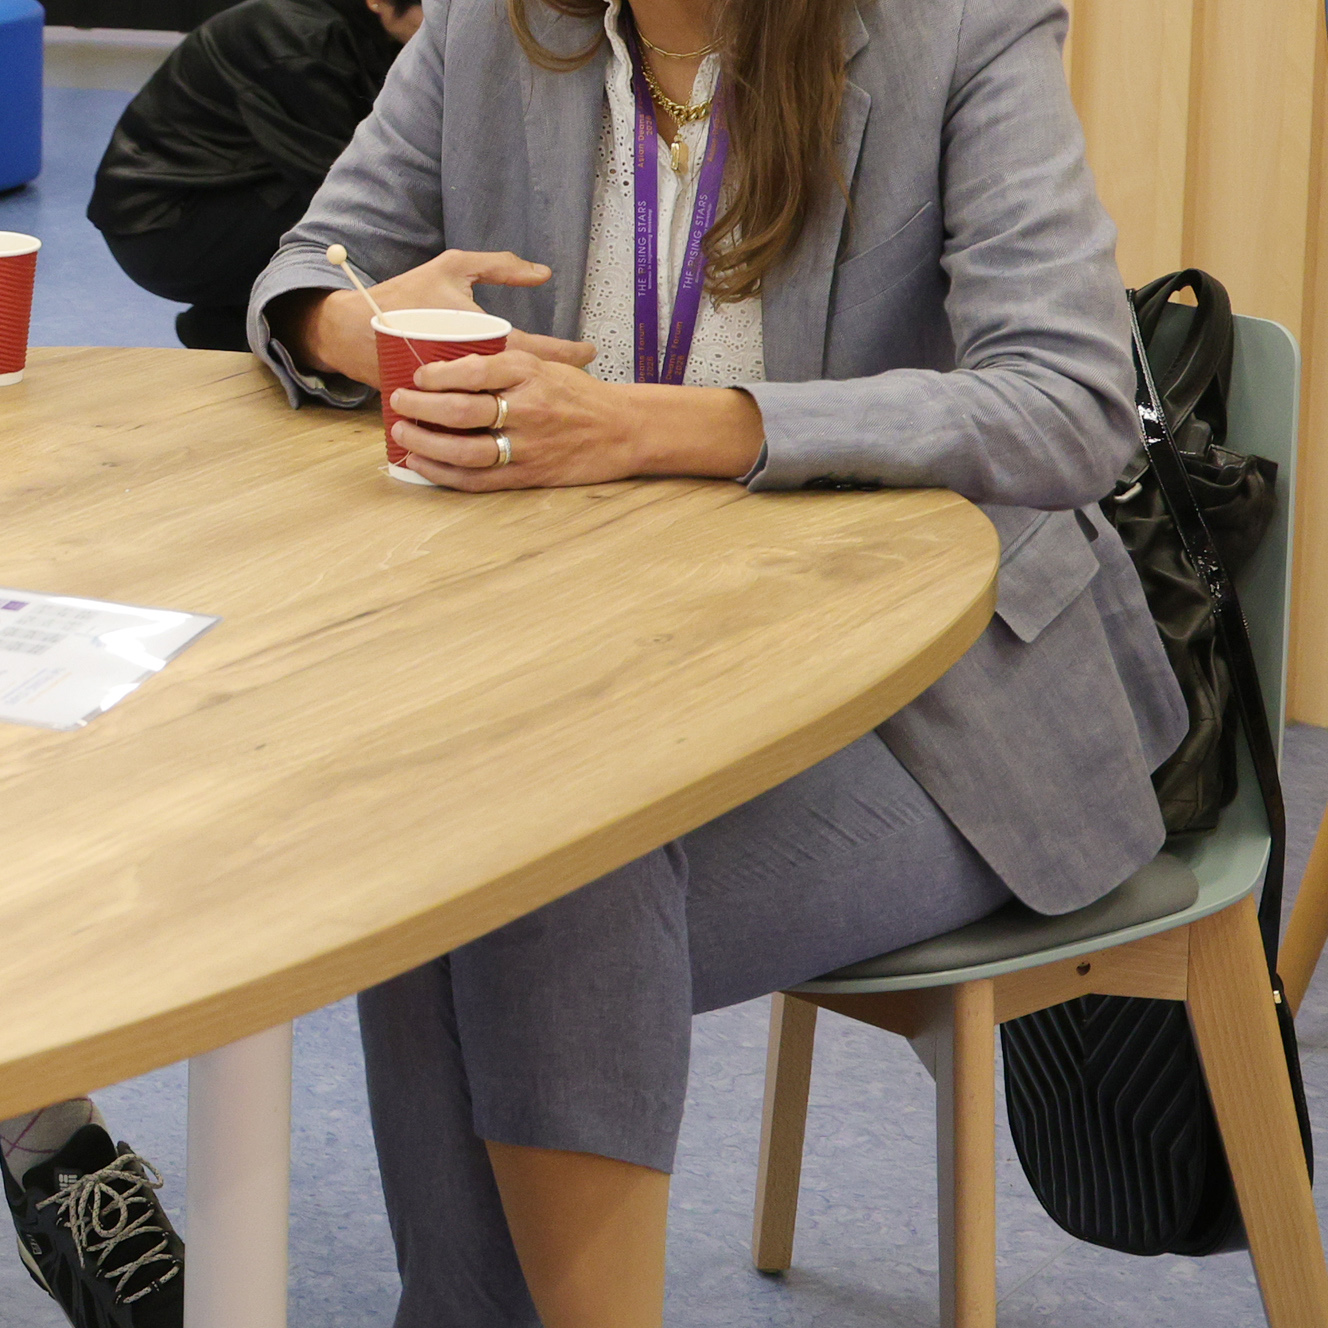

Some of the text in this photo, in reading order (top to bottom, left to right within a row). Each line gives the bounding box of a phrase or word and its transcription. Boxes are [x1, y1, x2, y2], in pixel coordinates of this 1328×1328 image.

[637, 200, 647, 232] STARS
[695, 194, 708, 226] STARS
[637, 278, 646, 296] THE
